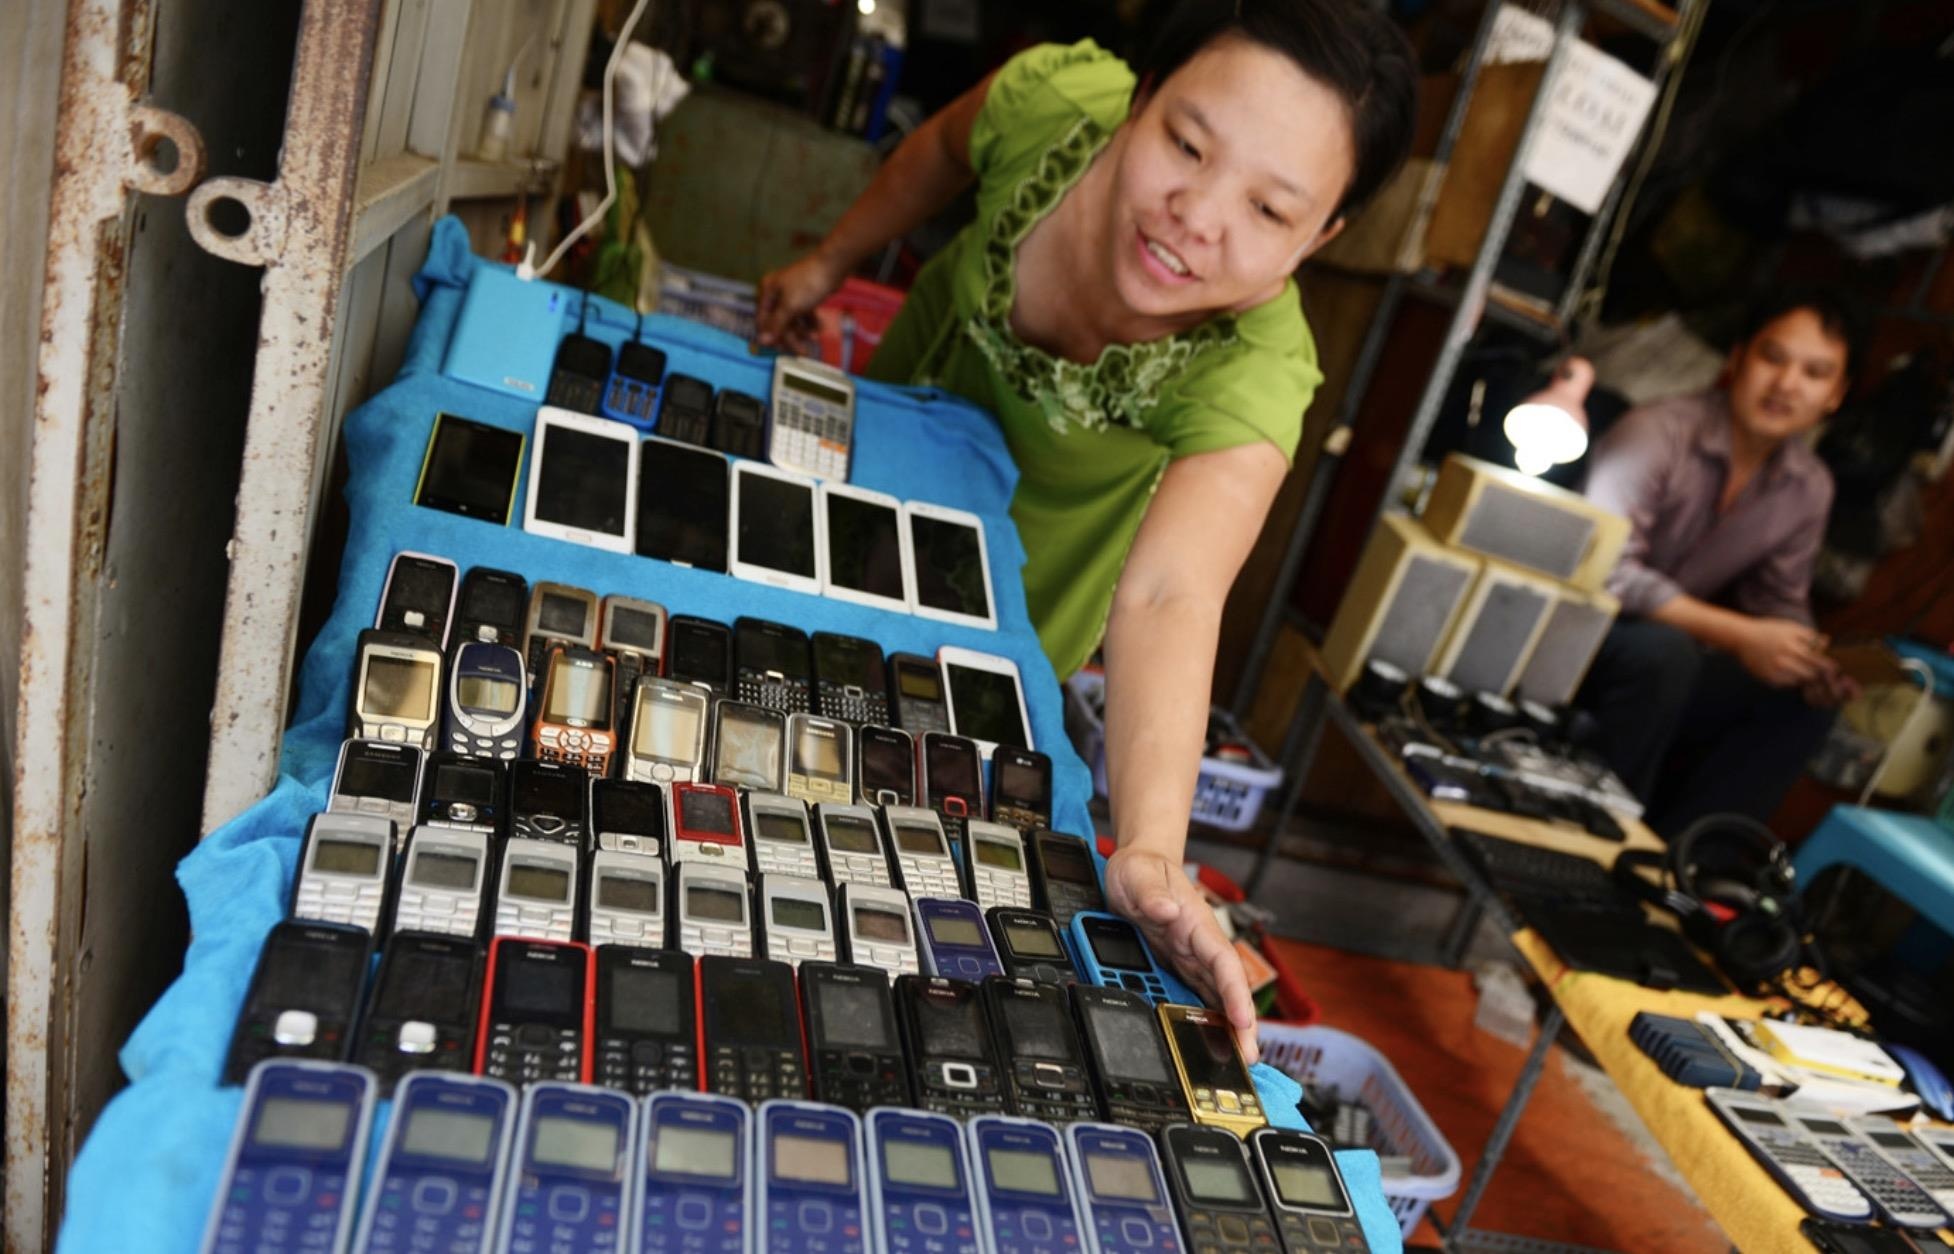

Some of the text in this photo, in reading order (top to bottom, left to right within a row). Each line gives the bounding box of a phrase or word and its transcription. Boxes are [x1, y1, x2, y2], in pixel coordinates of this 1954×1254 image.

[631, 959, 659, 968] NOKIA
[832, 974, 861, 983] NOKIA
[928, 988, 956, 997] NOKIA
[1014, 989, 1040, 998] NOKIA
[1102, 998, 1129, 1007] NOKIA
[1280, 1145, 1309, 1155] NOKIA
